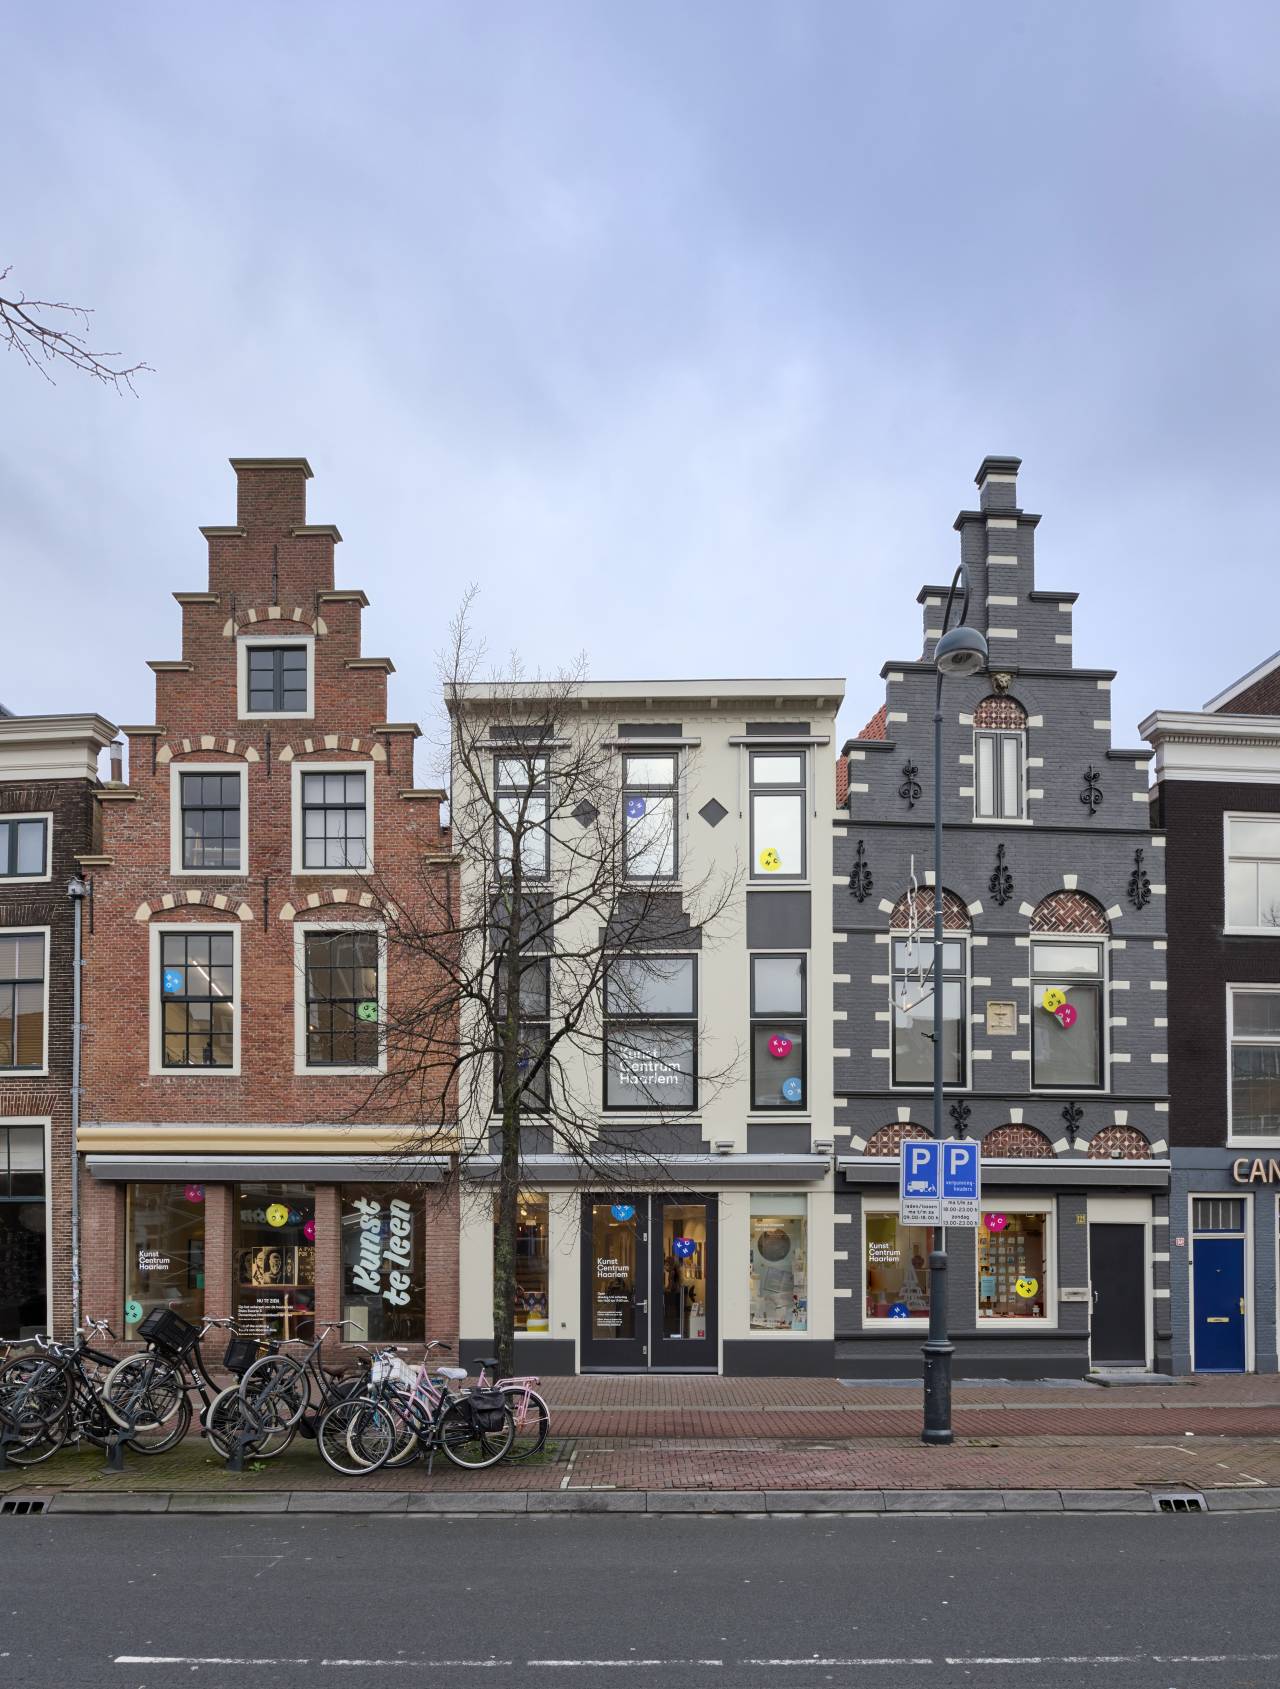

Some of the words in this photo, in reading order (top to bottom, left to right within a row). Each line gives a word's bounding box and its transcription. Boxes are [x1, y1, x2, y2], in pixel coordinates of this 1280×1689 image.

[619, 1046, 658, 1060] Kunst
[619, 1060, 681, 1072] Centrum
[619, 1072, 679, 1085] Haarlem
[912, 1148, 931, 1175] P
[950, 1148, 970, 1175] P
[1233, 1158, 1280, 1183] CAN
[352, 1196, 381, 1294] Kunst
[382, 1198, 411, 1268] leen
[597, 1257, 619, 1265] Kunst
[382, 1270, 411, 1306] te
